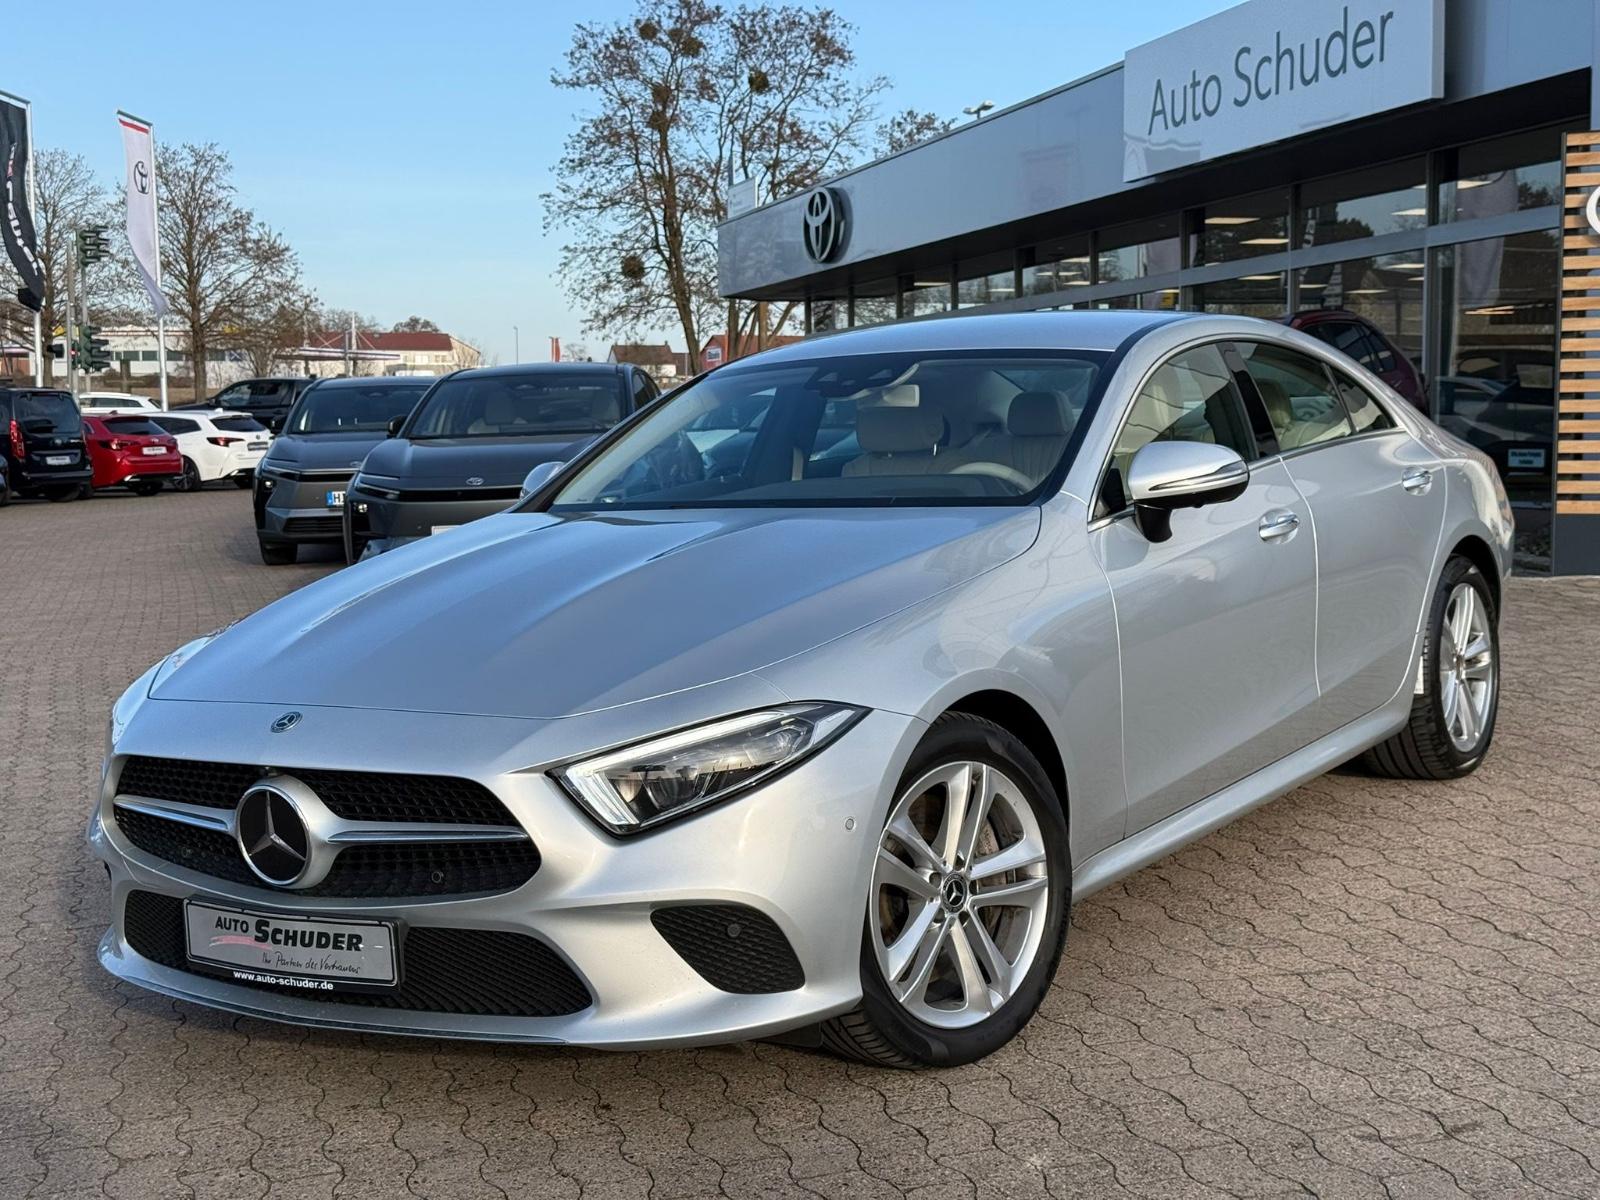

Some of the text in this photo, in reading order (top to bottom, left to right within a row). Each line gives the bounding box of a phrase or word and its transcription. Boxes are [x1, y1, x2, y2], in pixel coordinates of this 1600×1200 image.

[1148, 6, 1394, 135] Auto Schuder
[215, 916, 363, 951] AUTO SCHUDER
[305, 957, 318, 969] des
[233, 971, 334, 990] www.auto-schuder.de
